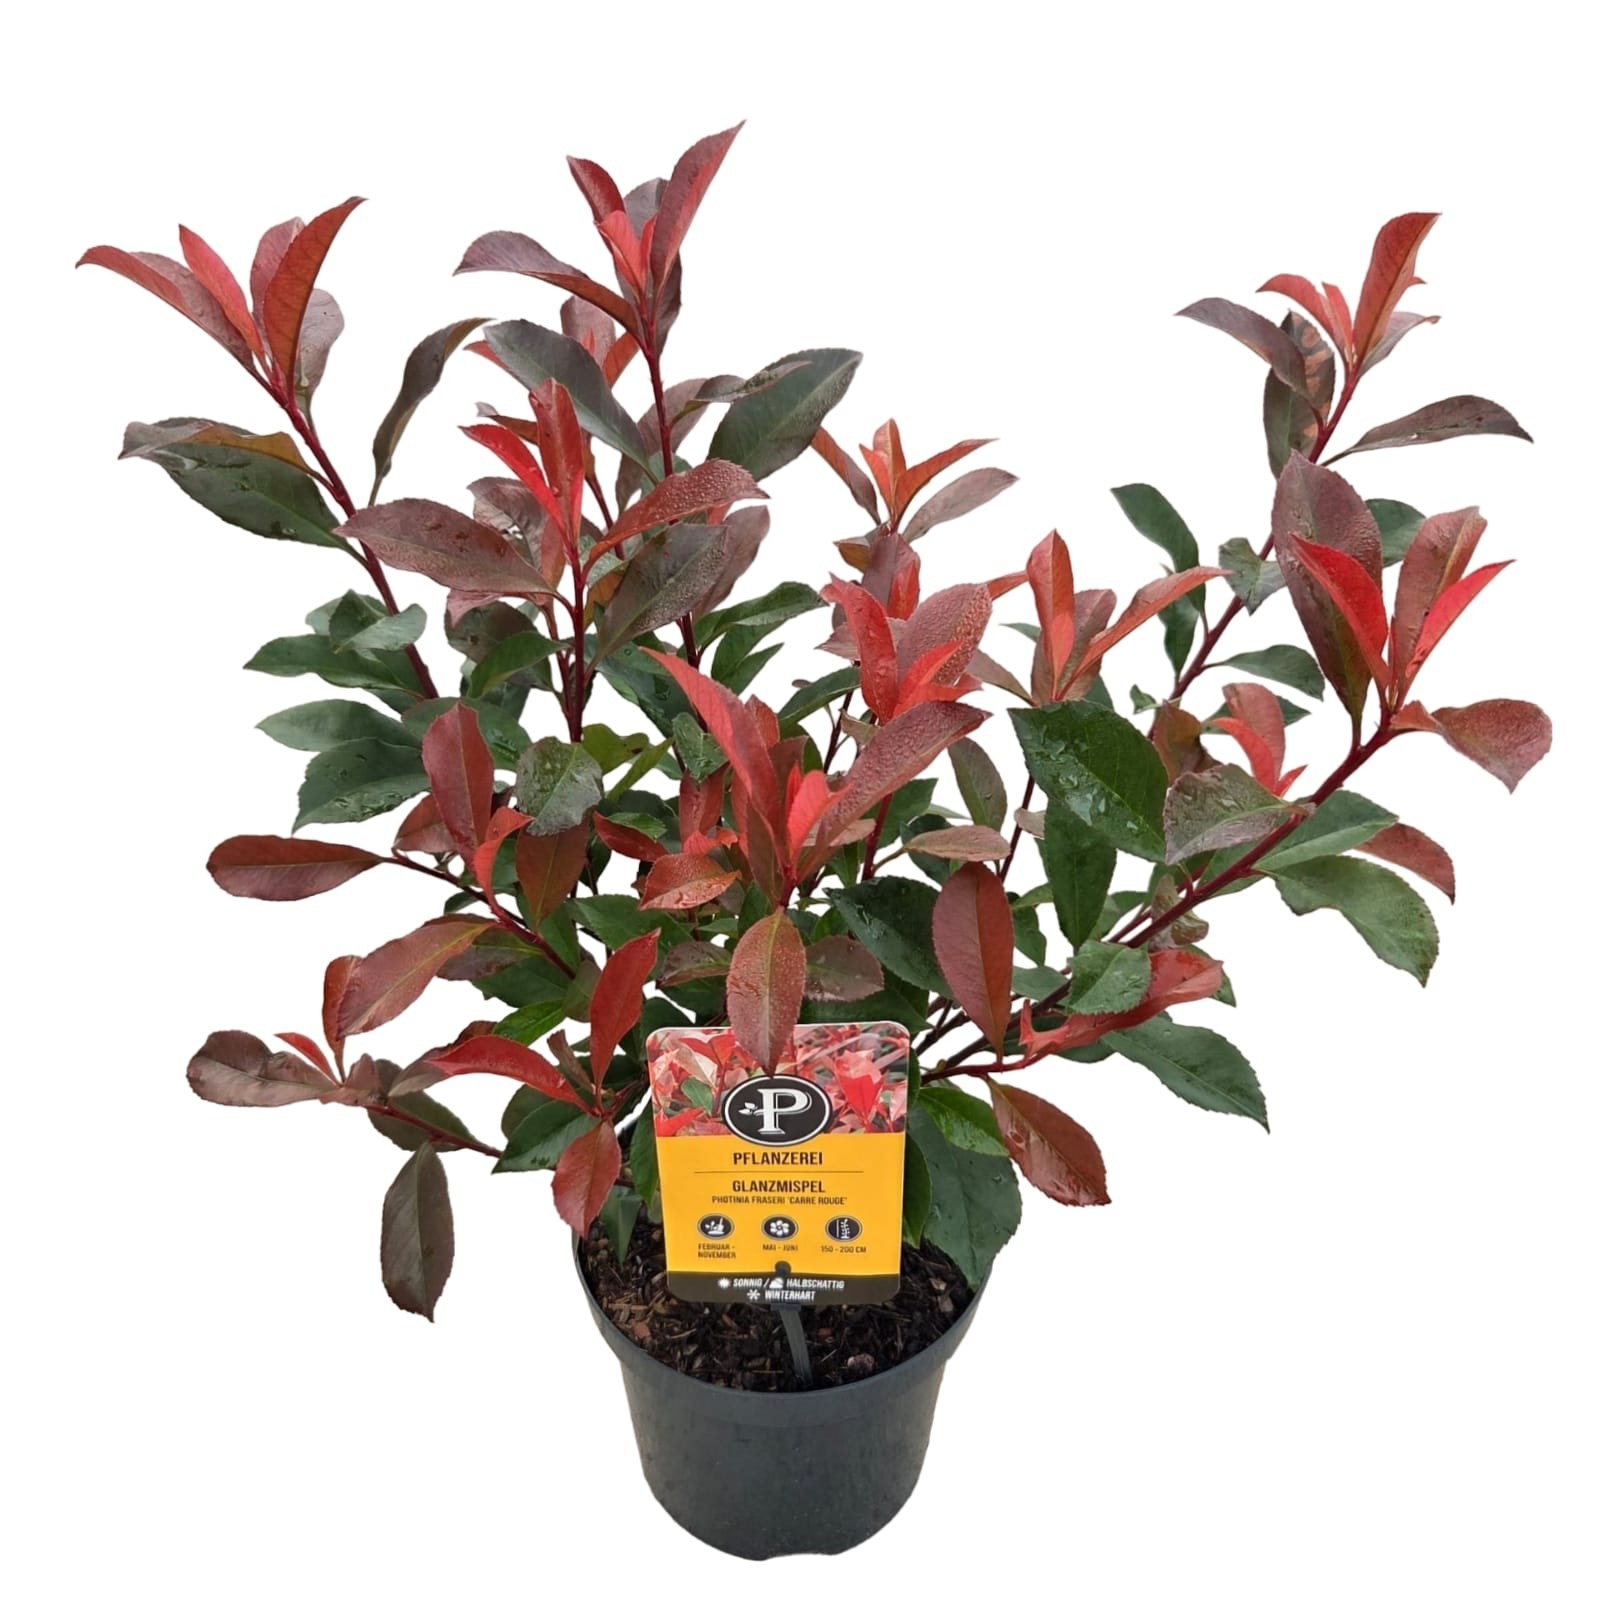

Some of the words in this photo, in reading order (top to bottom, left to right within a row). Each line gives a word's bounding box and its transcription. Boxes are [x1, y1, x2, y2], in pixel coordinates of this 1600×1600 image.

[757, 1088, 812, 1135] P
[733, 1152, 823, 1165] PFLANZEREI
[732, 1180, 826, 1193] GLANZMISPEL
[711, 1195, 749, 1204] PHOTINIA
[751, 1196, 785, 1204] FRASERI
[697, 1251, 736, 1259] NOVEMBER
[733, 1278, 763, 1287] SONNIG
[786, 1279, 845, 1289] HALBSCHATTIG
[764, 1290, 816, 1300] WINTERHART
